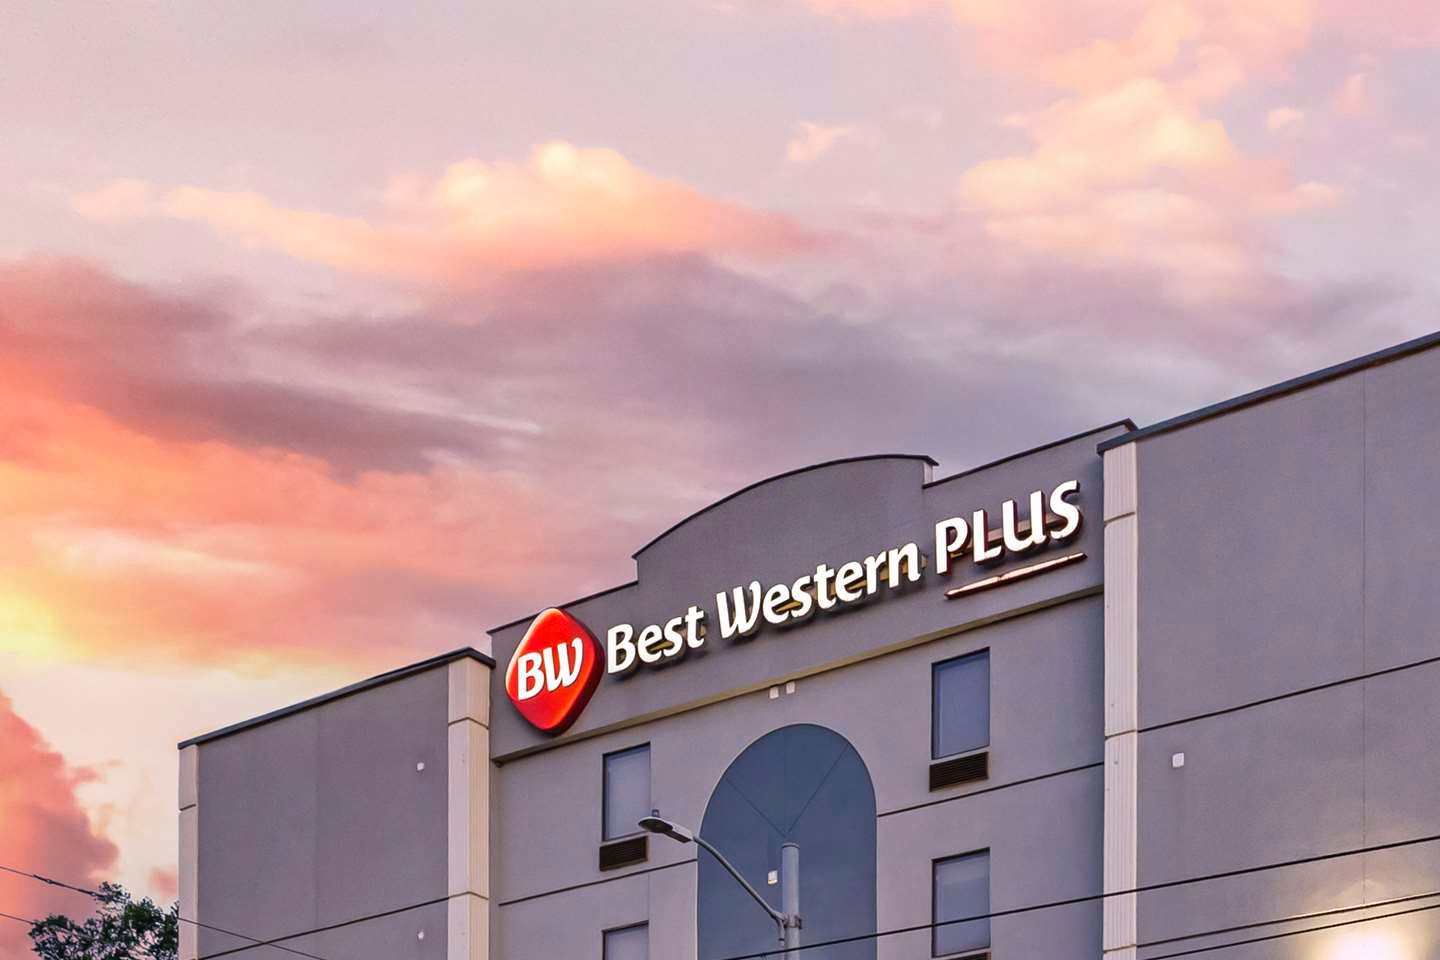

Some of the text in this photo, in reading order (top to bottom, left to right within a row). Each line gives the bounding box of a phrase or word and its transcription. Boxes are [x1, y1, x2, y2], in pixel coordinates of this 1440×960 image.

[607, 480, 1082, 675] Best Western PLUS
[517, 637, 584, 701] BW
